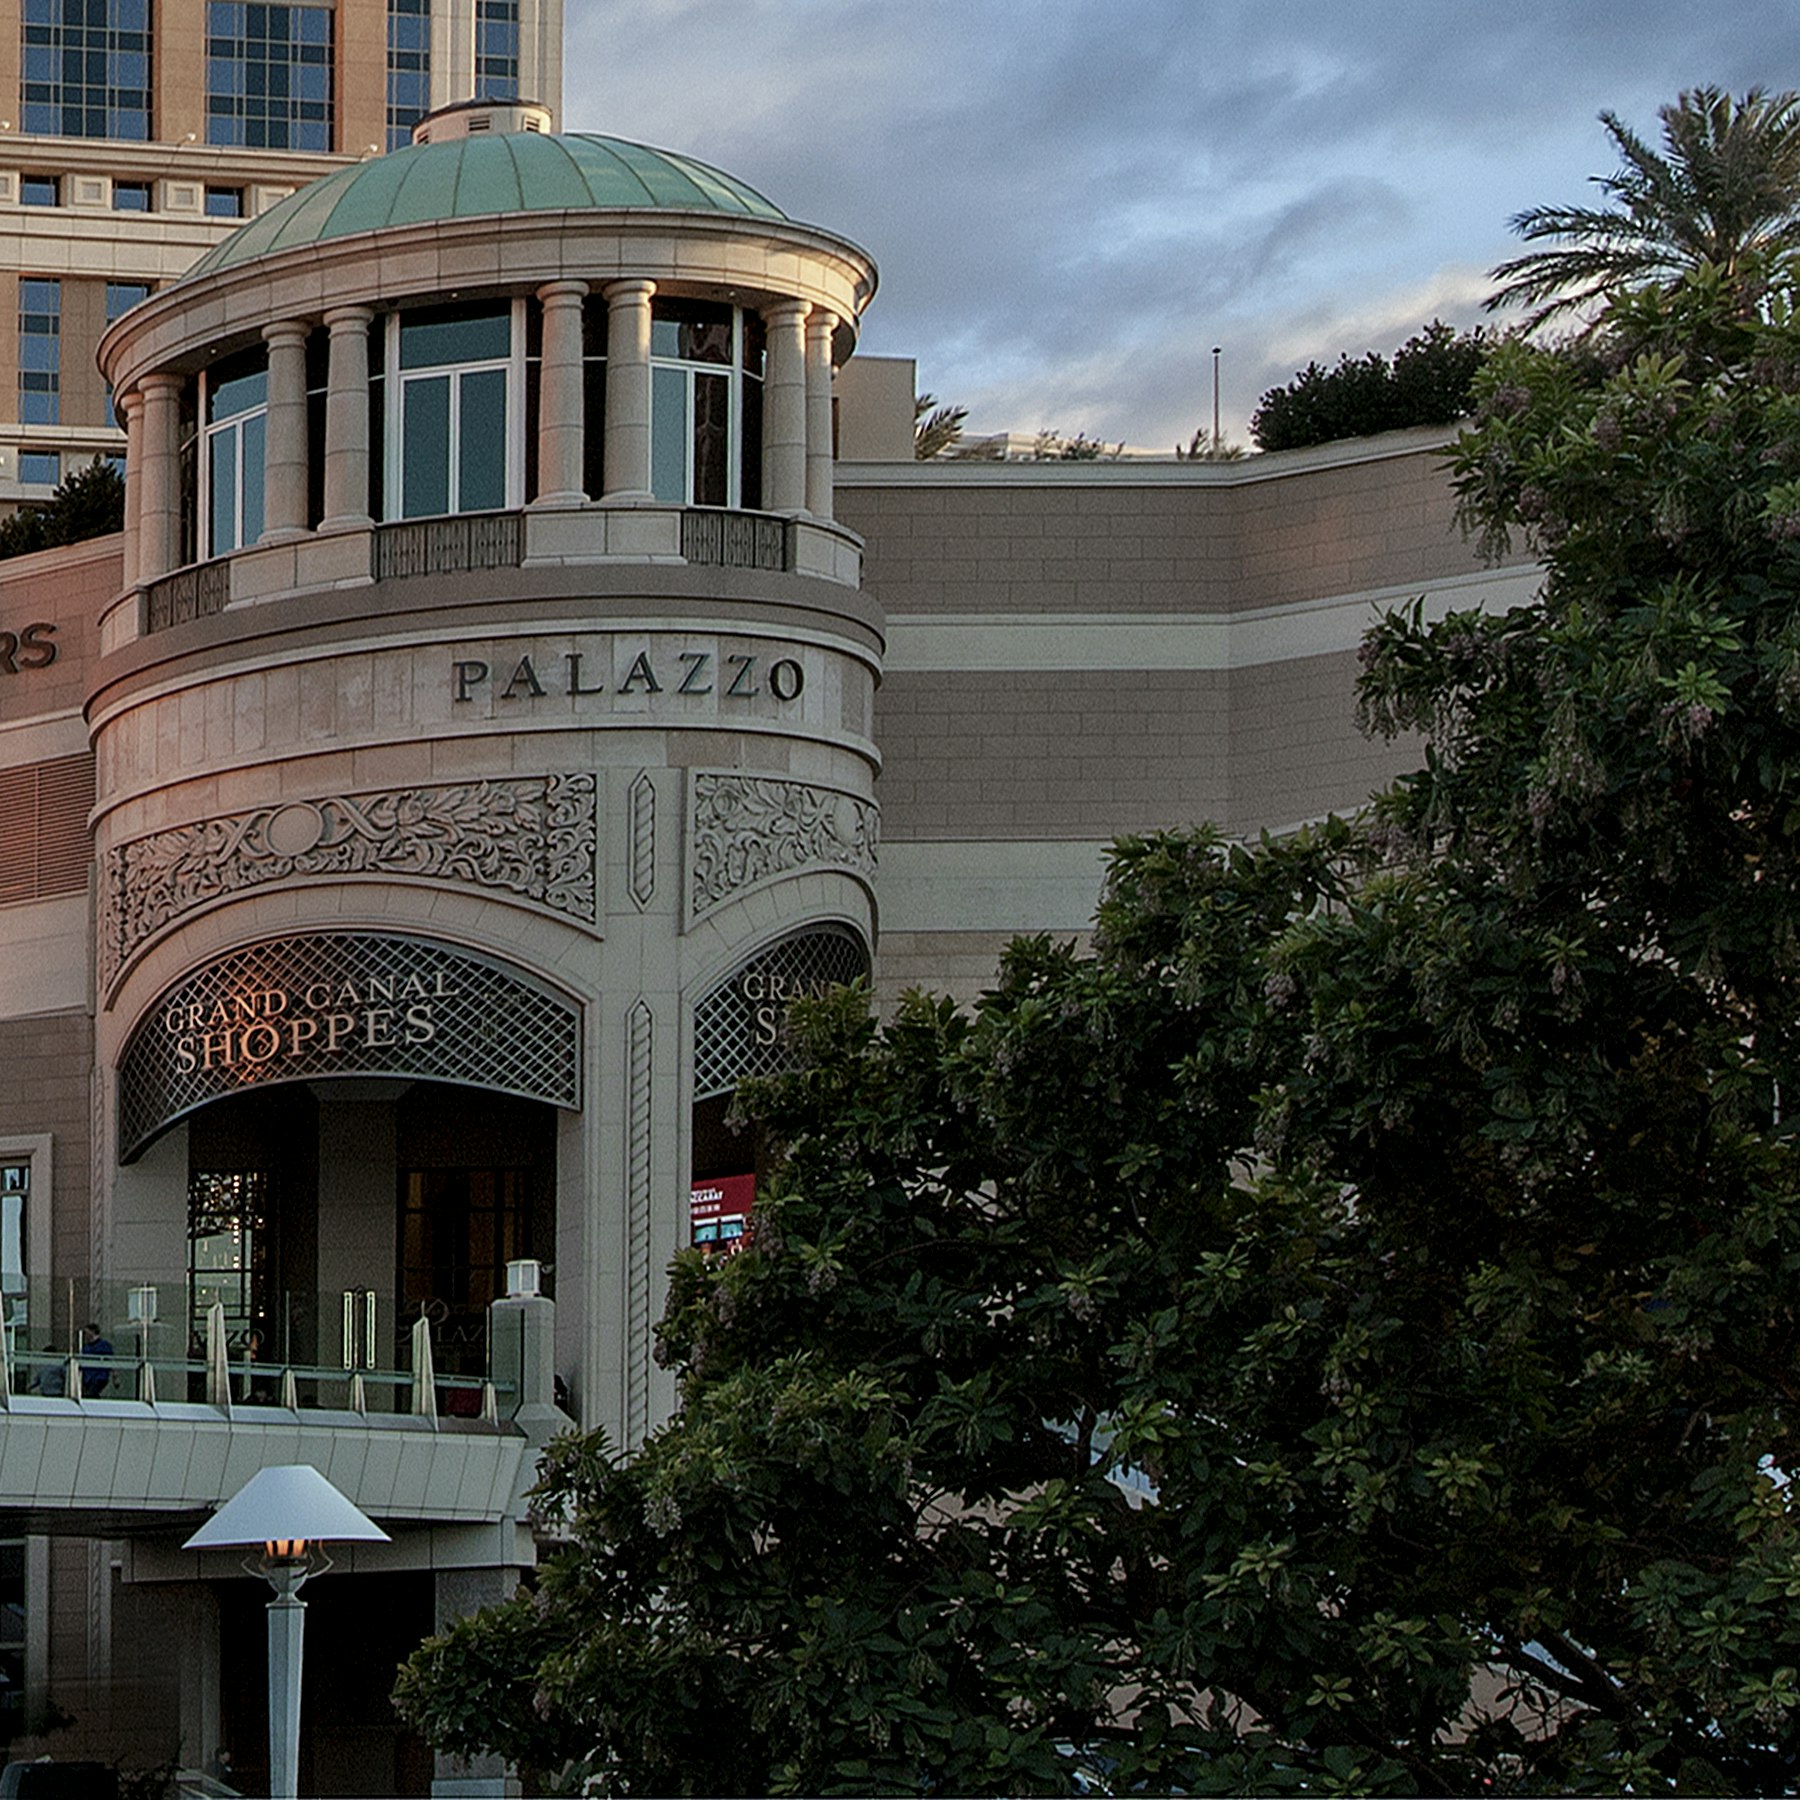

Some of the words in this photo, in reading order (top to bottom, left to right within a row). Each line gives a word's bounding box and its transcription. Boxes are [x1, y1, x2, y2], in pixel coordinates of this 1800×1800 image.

[451, 650, 805, 702] PALAZZO
[165, 988, 288, 1034] GRAND
[305, 971, 460, 1011] CANAL
[742, 972, 828, 1001] GRAN
[176, 1003, 437, 1075] SHOPPES
